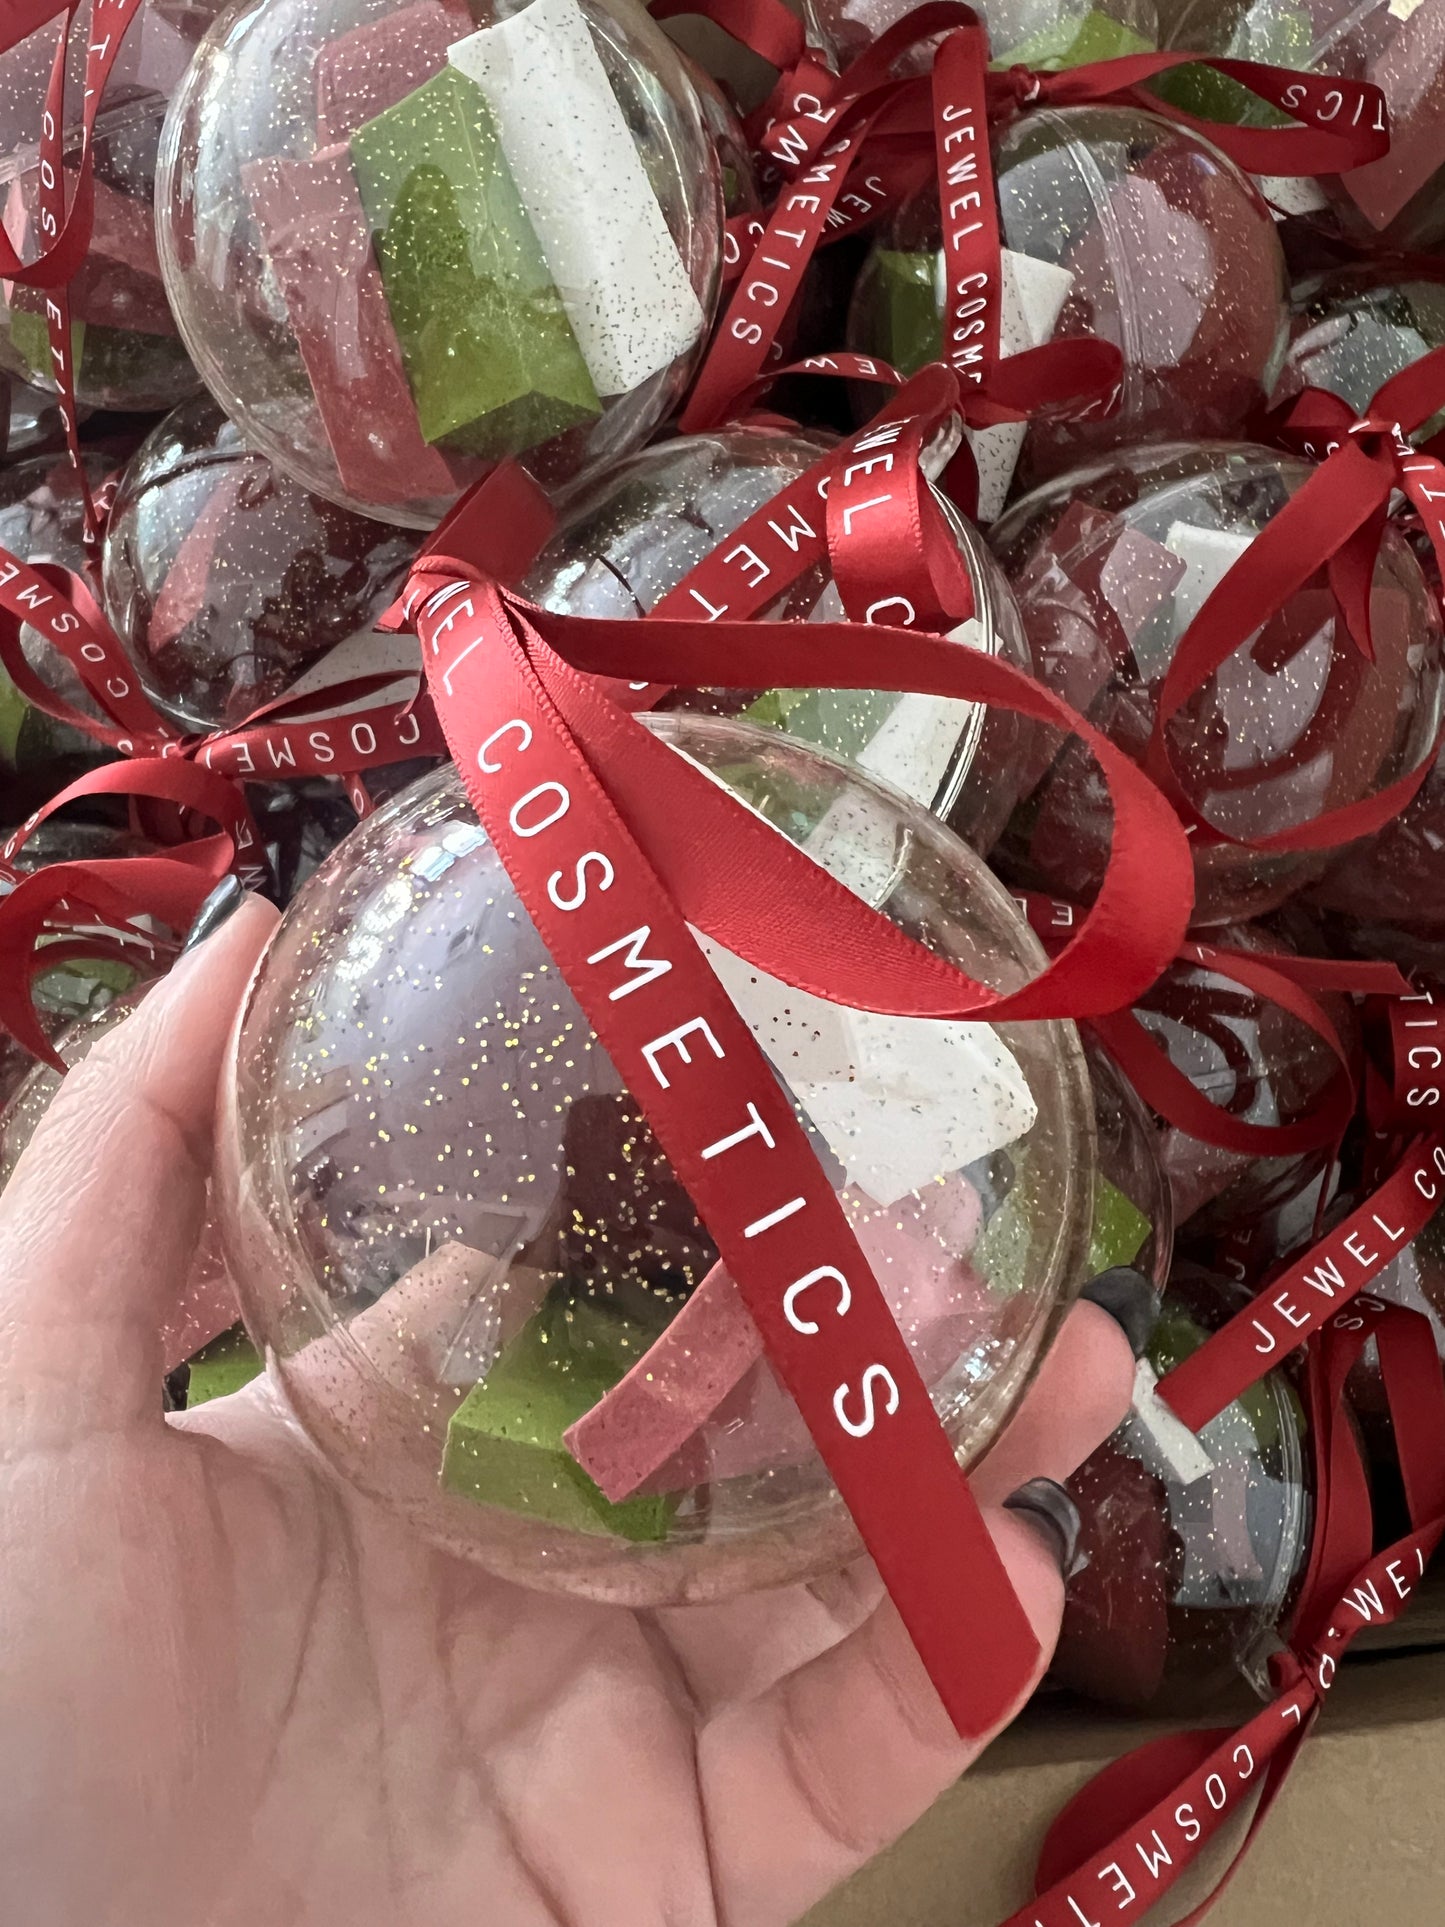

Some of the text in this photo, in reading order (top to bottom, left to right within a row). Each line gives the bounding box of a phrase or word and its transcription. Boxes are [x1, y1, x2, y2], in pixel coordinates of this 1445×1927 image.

[942, 105, 983, 251] JEWEL
[843, 415, 919, 535] WEL
[477, 718, 900, 1438] COSMETICS
[1252, 1214, 1405, 1353] JEWEL
[1034, 1744, 1254, 1927] COSMET
